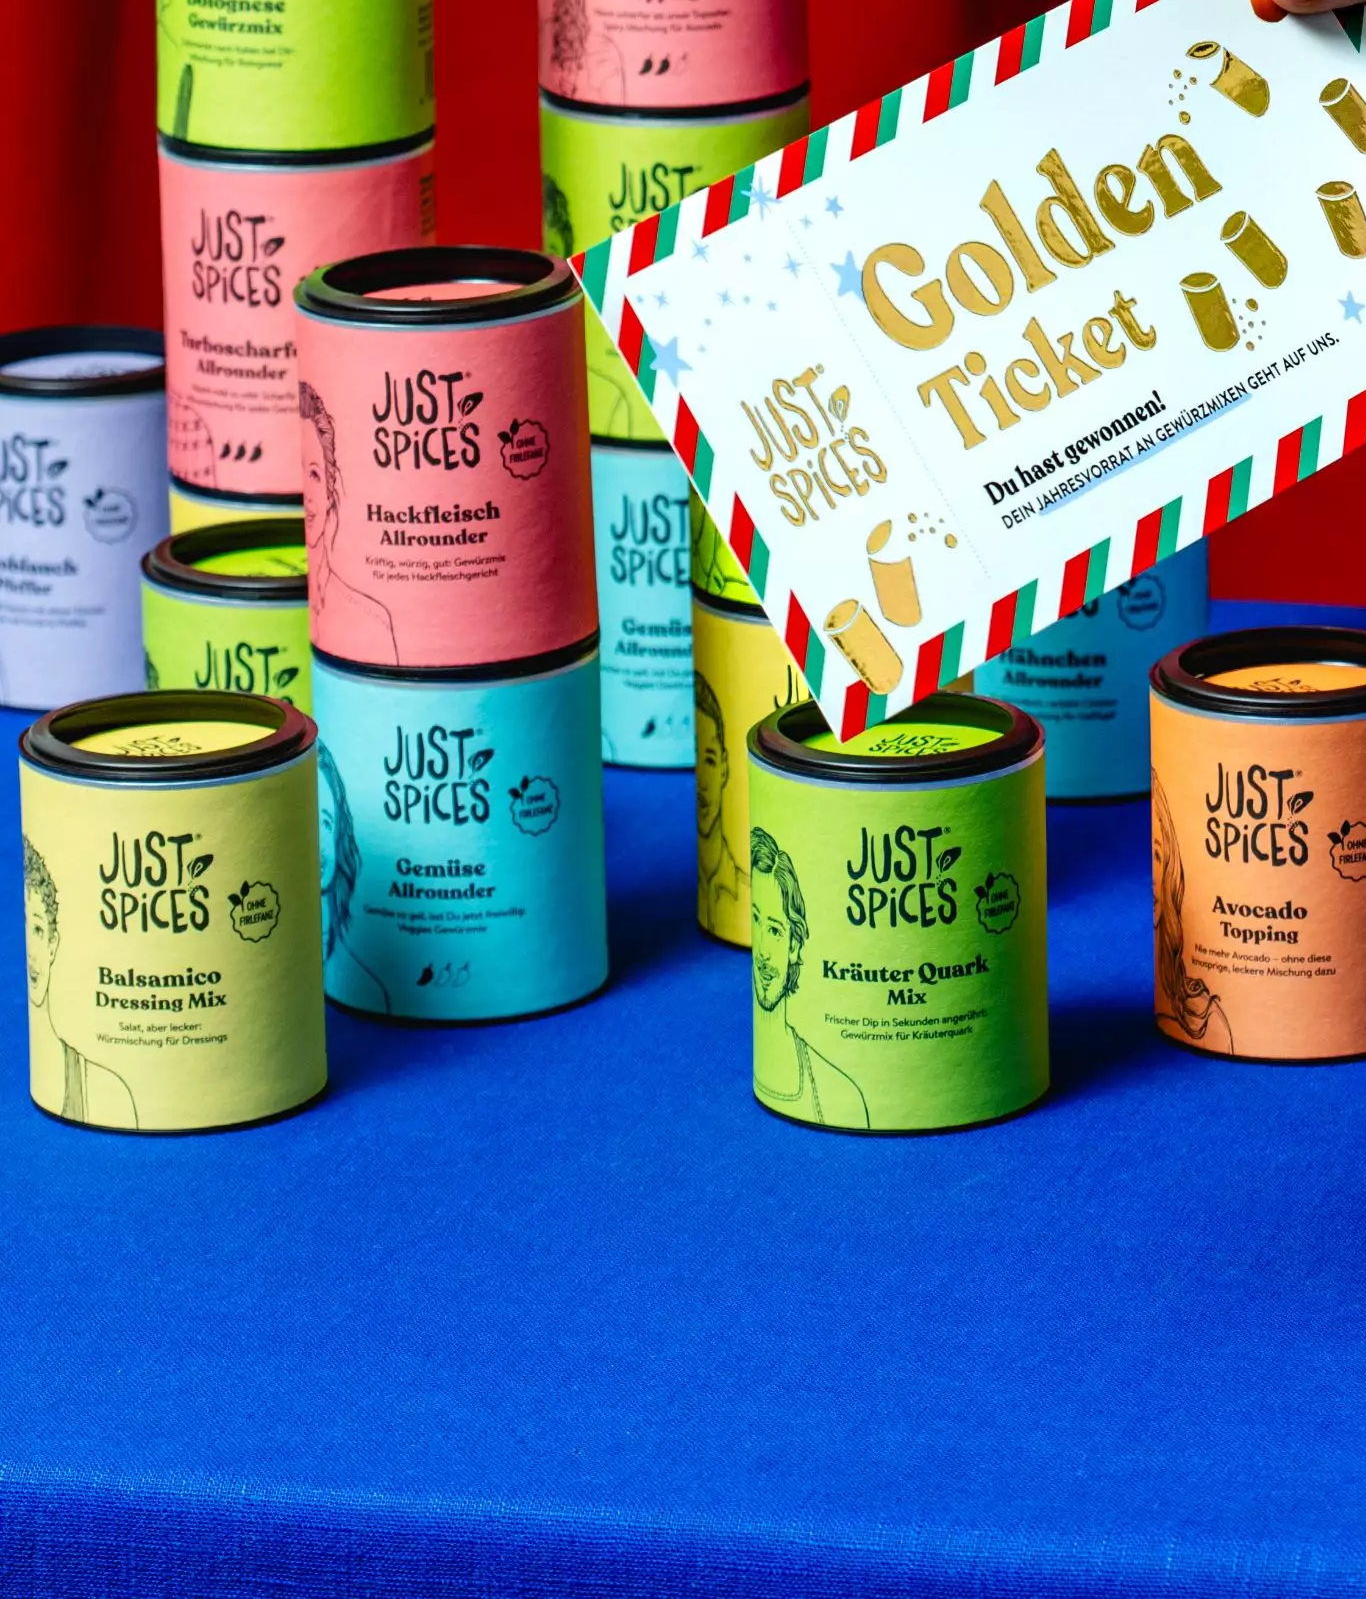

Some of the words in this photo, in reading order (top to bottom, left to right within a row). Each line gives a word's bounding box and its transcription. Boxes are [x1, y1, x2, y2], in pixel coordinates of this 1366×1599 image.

[188, 12, 283, 34] Gewürzmix
[861, 133, 1223, 351] Golden
[197, 359, 286, 380] Allrounder
[917, 290, 1157, 450] Ticket
[740, 366, 838, 472] JUST
[1001, 501, 1037, 529] DEIN
[1038, 445, 1135, 511] JAHRESVORRAT
[1135, 433, 1157, 455] AN
[1155, 381, 1249, 442] GEWÜRZMIXEN
[1247, 362, 1282, 390] GEHT
[1282, 347, 1308, 372] AUF
[1306, 332, 1341, 356] UNS.
[983, 477, 1021, 505] Du
[1014, 450, 1065, 488] hast
[1064, 390, 1167, 465] gewonnen!
[366, 501, 501, 524] Hackfleisch
[380, 529, 488, 546] Allrounder
[454, 554, 506, 567] Gewürzmix
[372, 570, 386, 580] für
[387, 572, 410, 584] jedes
[412, 568, 499, 582] Hackfleischgericht
[1003, 671, 1102, 689] Allrounder
[396, 857, 486, 878] Gemüse
[388, 881, 496, 900] Allrounder
[247, 899, 267, 913] OHNE
[1212, 895, 1308, 920] Avocado
[239, 911, 274, 927] FIRLEFANZ
[1219, 921, 1299, 945] Topping
[1194, 943, 1208, 954] Nie
[1208, 947, 1230, 959] mehr
[1231, 951, 1271, 963] Avocado
[1281, 954, 1305, 964] ohne
[1307, 953, 1332, 963] diese
[98, 966, 222, 988] Balsamico
[822, 960, 914, 983] Kräuter
[918, 954, 990, 985] Quark
[1191, 956, 1231, 974] knusprige,
[1232, 964, 1264, 976] leckere
[1266, 966, 1312, 978] Mischung
[1314, 967, 1336, 976] dazu
[95, 991, 183, 1012] Dressing
[188, 990, 228, 1009] Mix
[887, 988, 927, 1006] Mix
[118, 1022, 144, 1033] Salat,
[146, 1022, 168, 1032] aber
[170, 1022, 203, 1032] lecker:
[824, 1014, 861, 1026] Frischer
[862, 1017, 879, 1028] Dip
[881, 1018, 890, 1027] in
[892, 1017, 939, 1028] Sekunden
[96, 1033, 163, 1048] Würzmischung
[165, 1036, 180, 1046] für
[182, 1034, 228, 1045] Dressings
[840, 1029, 894, 1041] Gewürzmix
[896, 1030, 911, 1041] für
[912, 1025, 973, 1039] Kräuterquark
